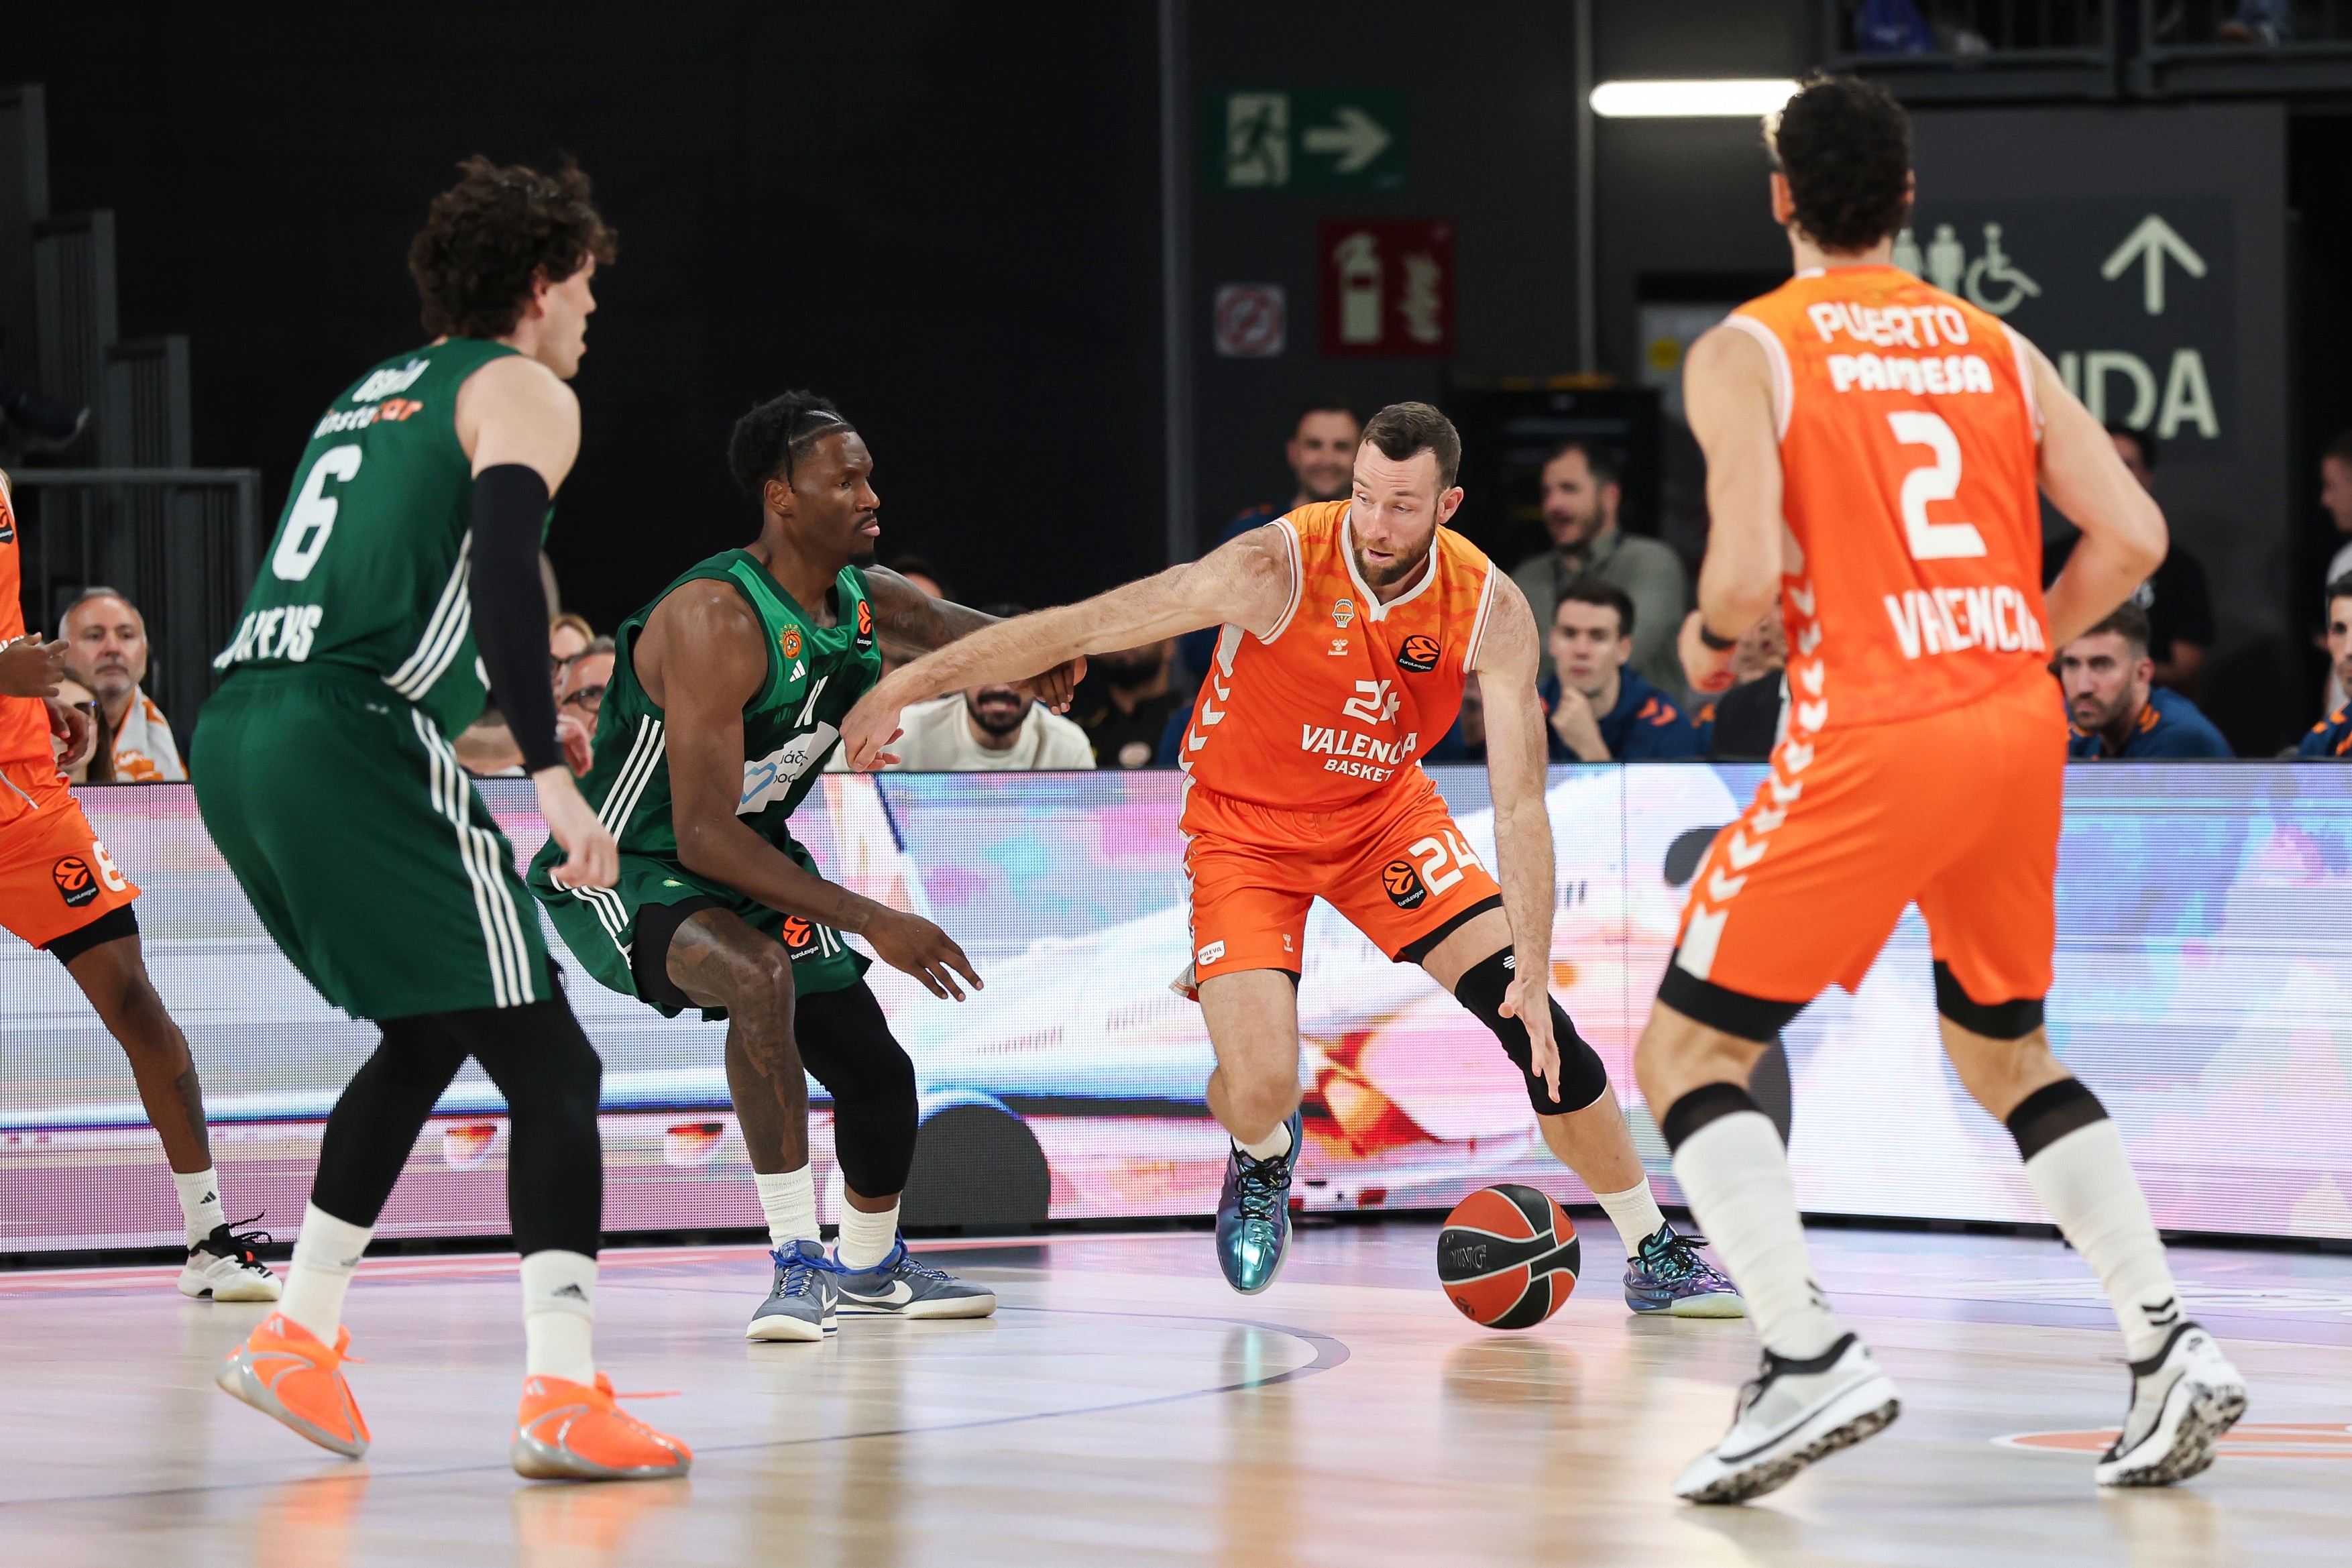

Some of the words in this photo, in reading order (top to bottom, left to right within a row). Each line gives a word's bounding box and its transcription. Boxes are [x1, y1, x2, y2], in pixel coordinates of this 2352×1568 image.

[1807, 301, 1970, 349] PUERTO
[1826, 351, 1995, 396] PAMESA
[1887, 410, 1986, 561] 2
[271, 444, 363, 581] 6
[1399, 658, 1432, 670] EuroLeague
[1342, 679, 1401, 726] 24
[1323, 759, 1395, 782] BASKET
[1408, 830, 1486, 897] 24
[1398, 889, 1424, 907] EuroLeague
[791, 946, 819, 960] EuroLeague
